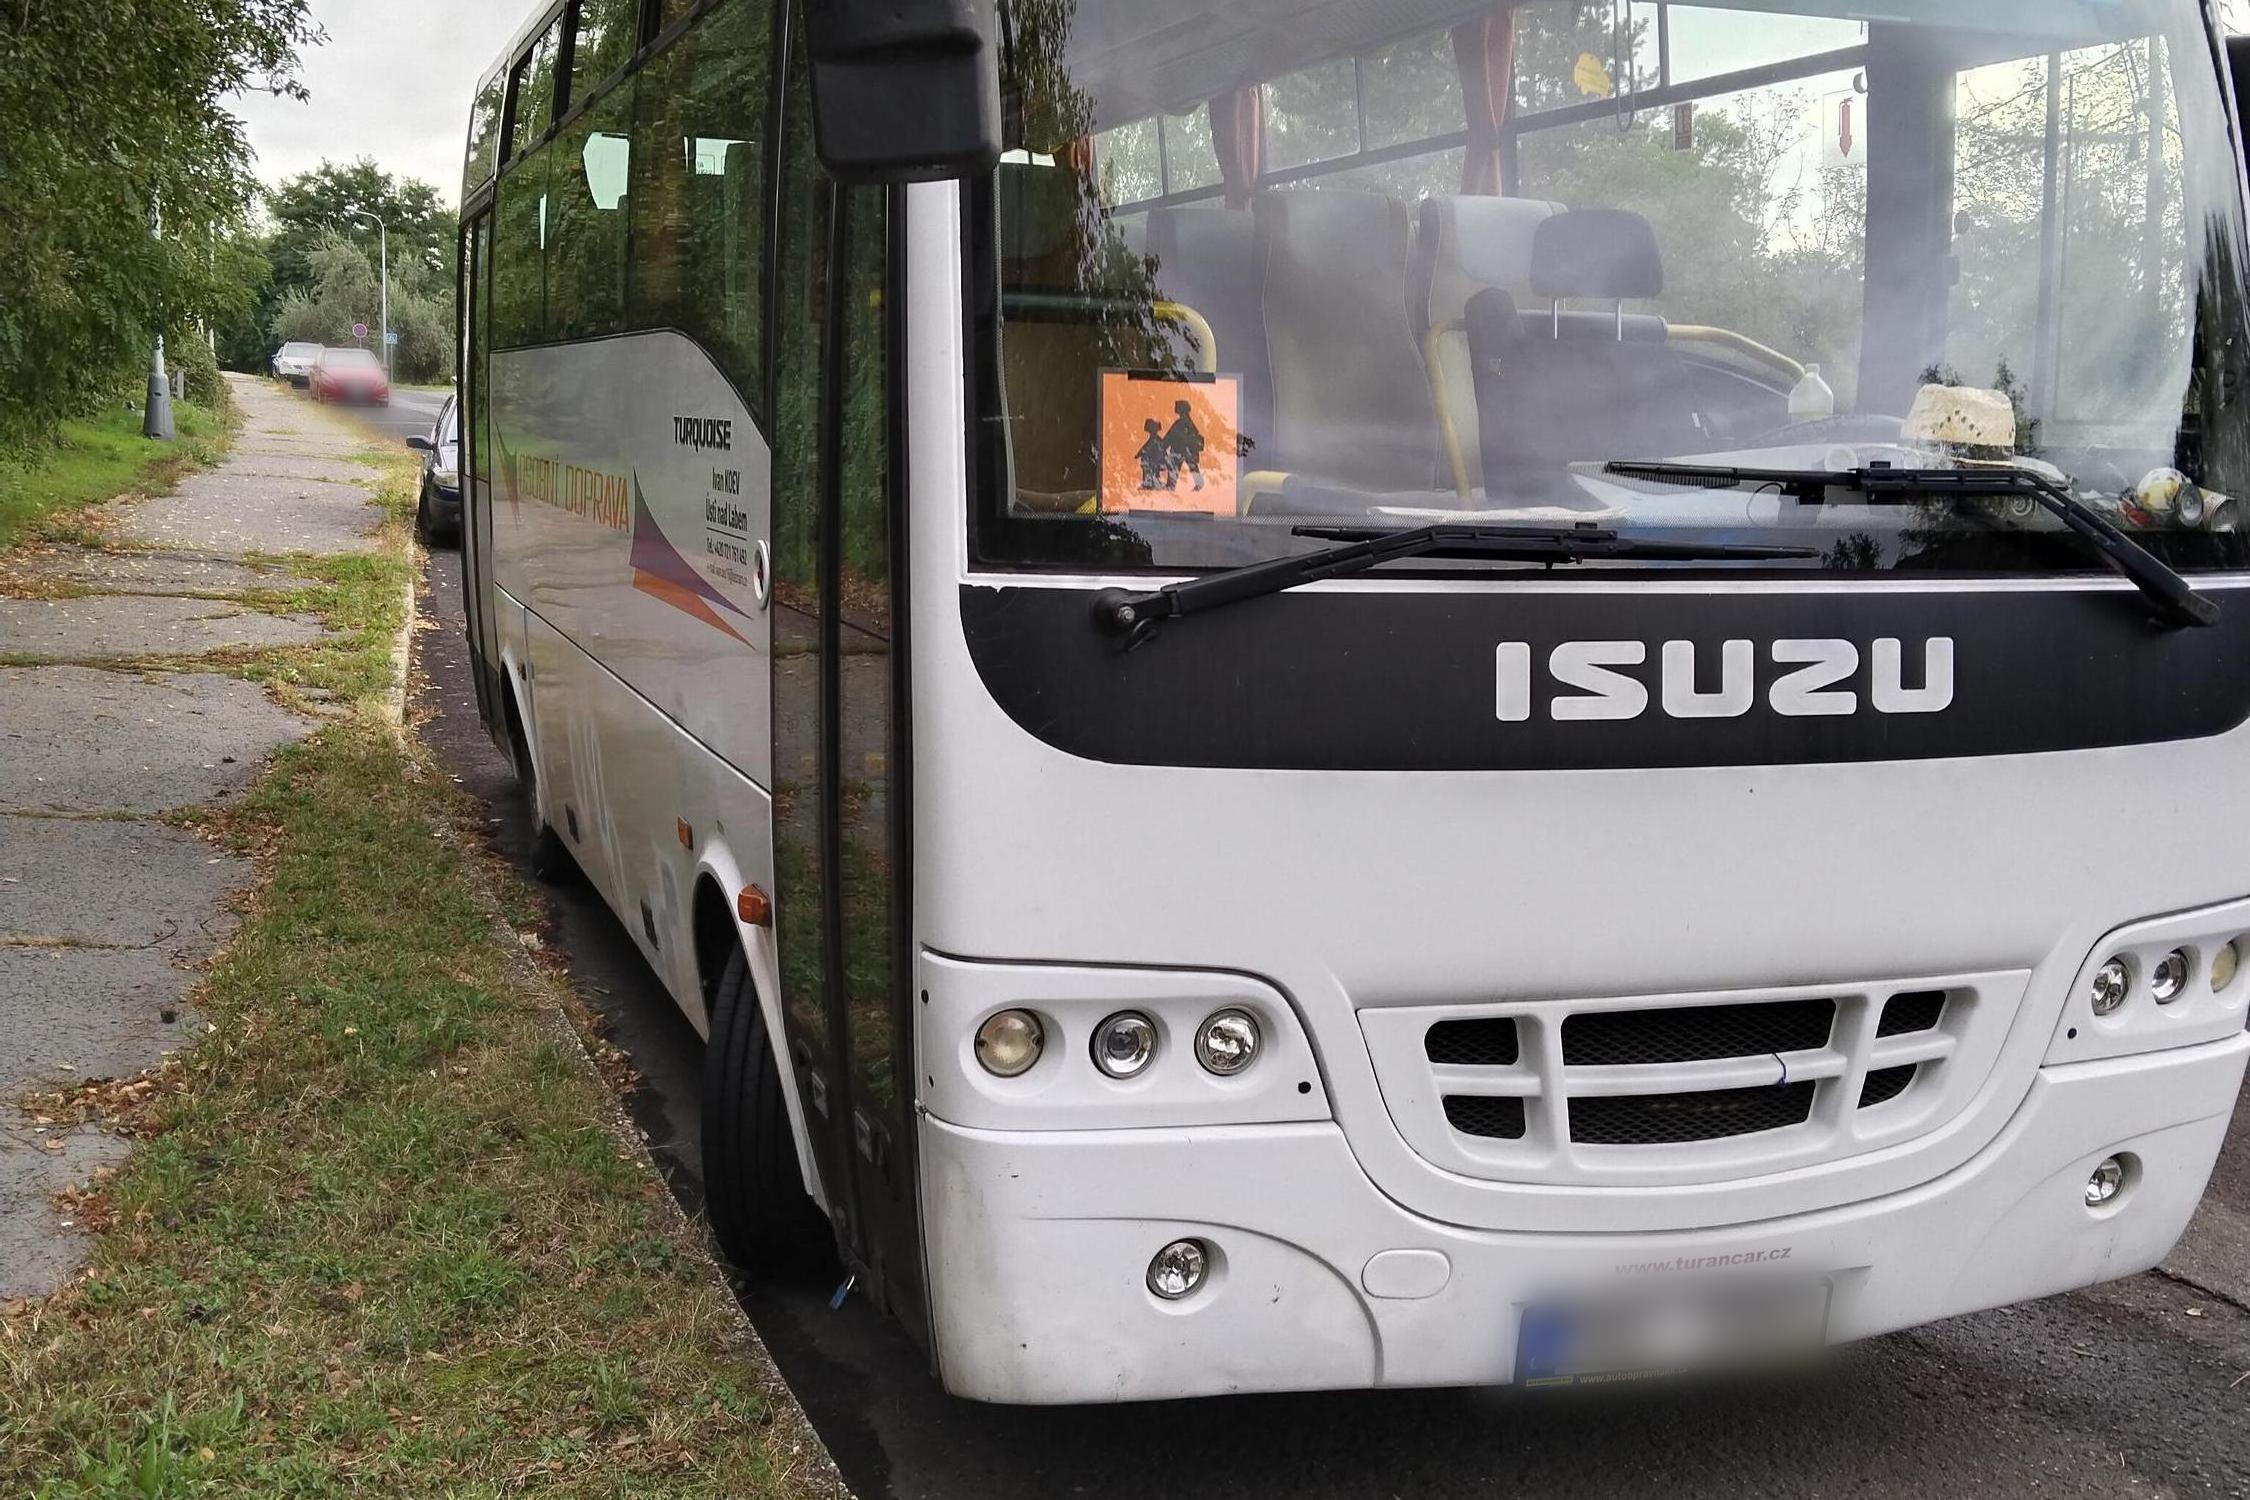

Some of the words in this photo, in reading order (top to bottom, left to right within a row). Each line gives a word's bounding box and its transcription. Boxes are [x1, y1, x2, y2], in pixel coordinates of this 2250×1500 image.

[673, 416, 732, 453] TURQUOISE
[712, 466, 724, 492] Ivan
[565, 464, 630, 533] DOPRAVA
[717, 501, 728, 527] nad
[728, 503, 748, 532] Labem
[1496, 636, 1954, 721] ISUZU
[1615, 1245, 1792, 1275] www.turancar.cz
